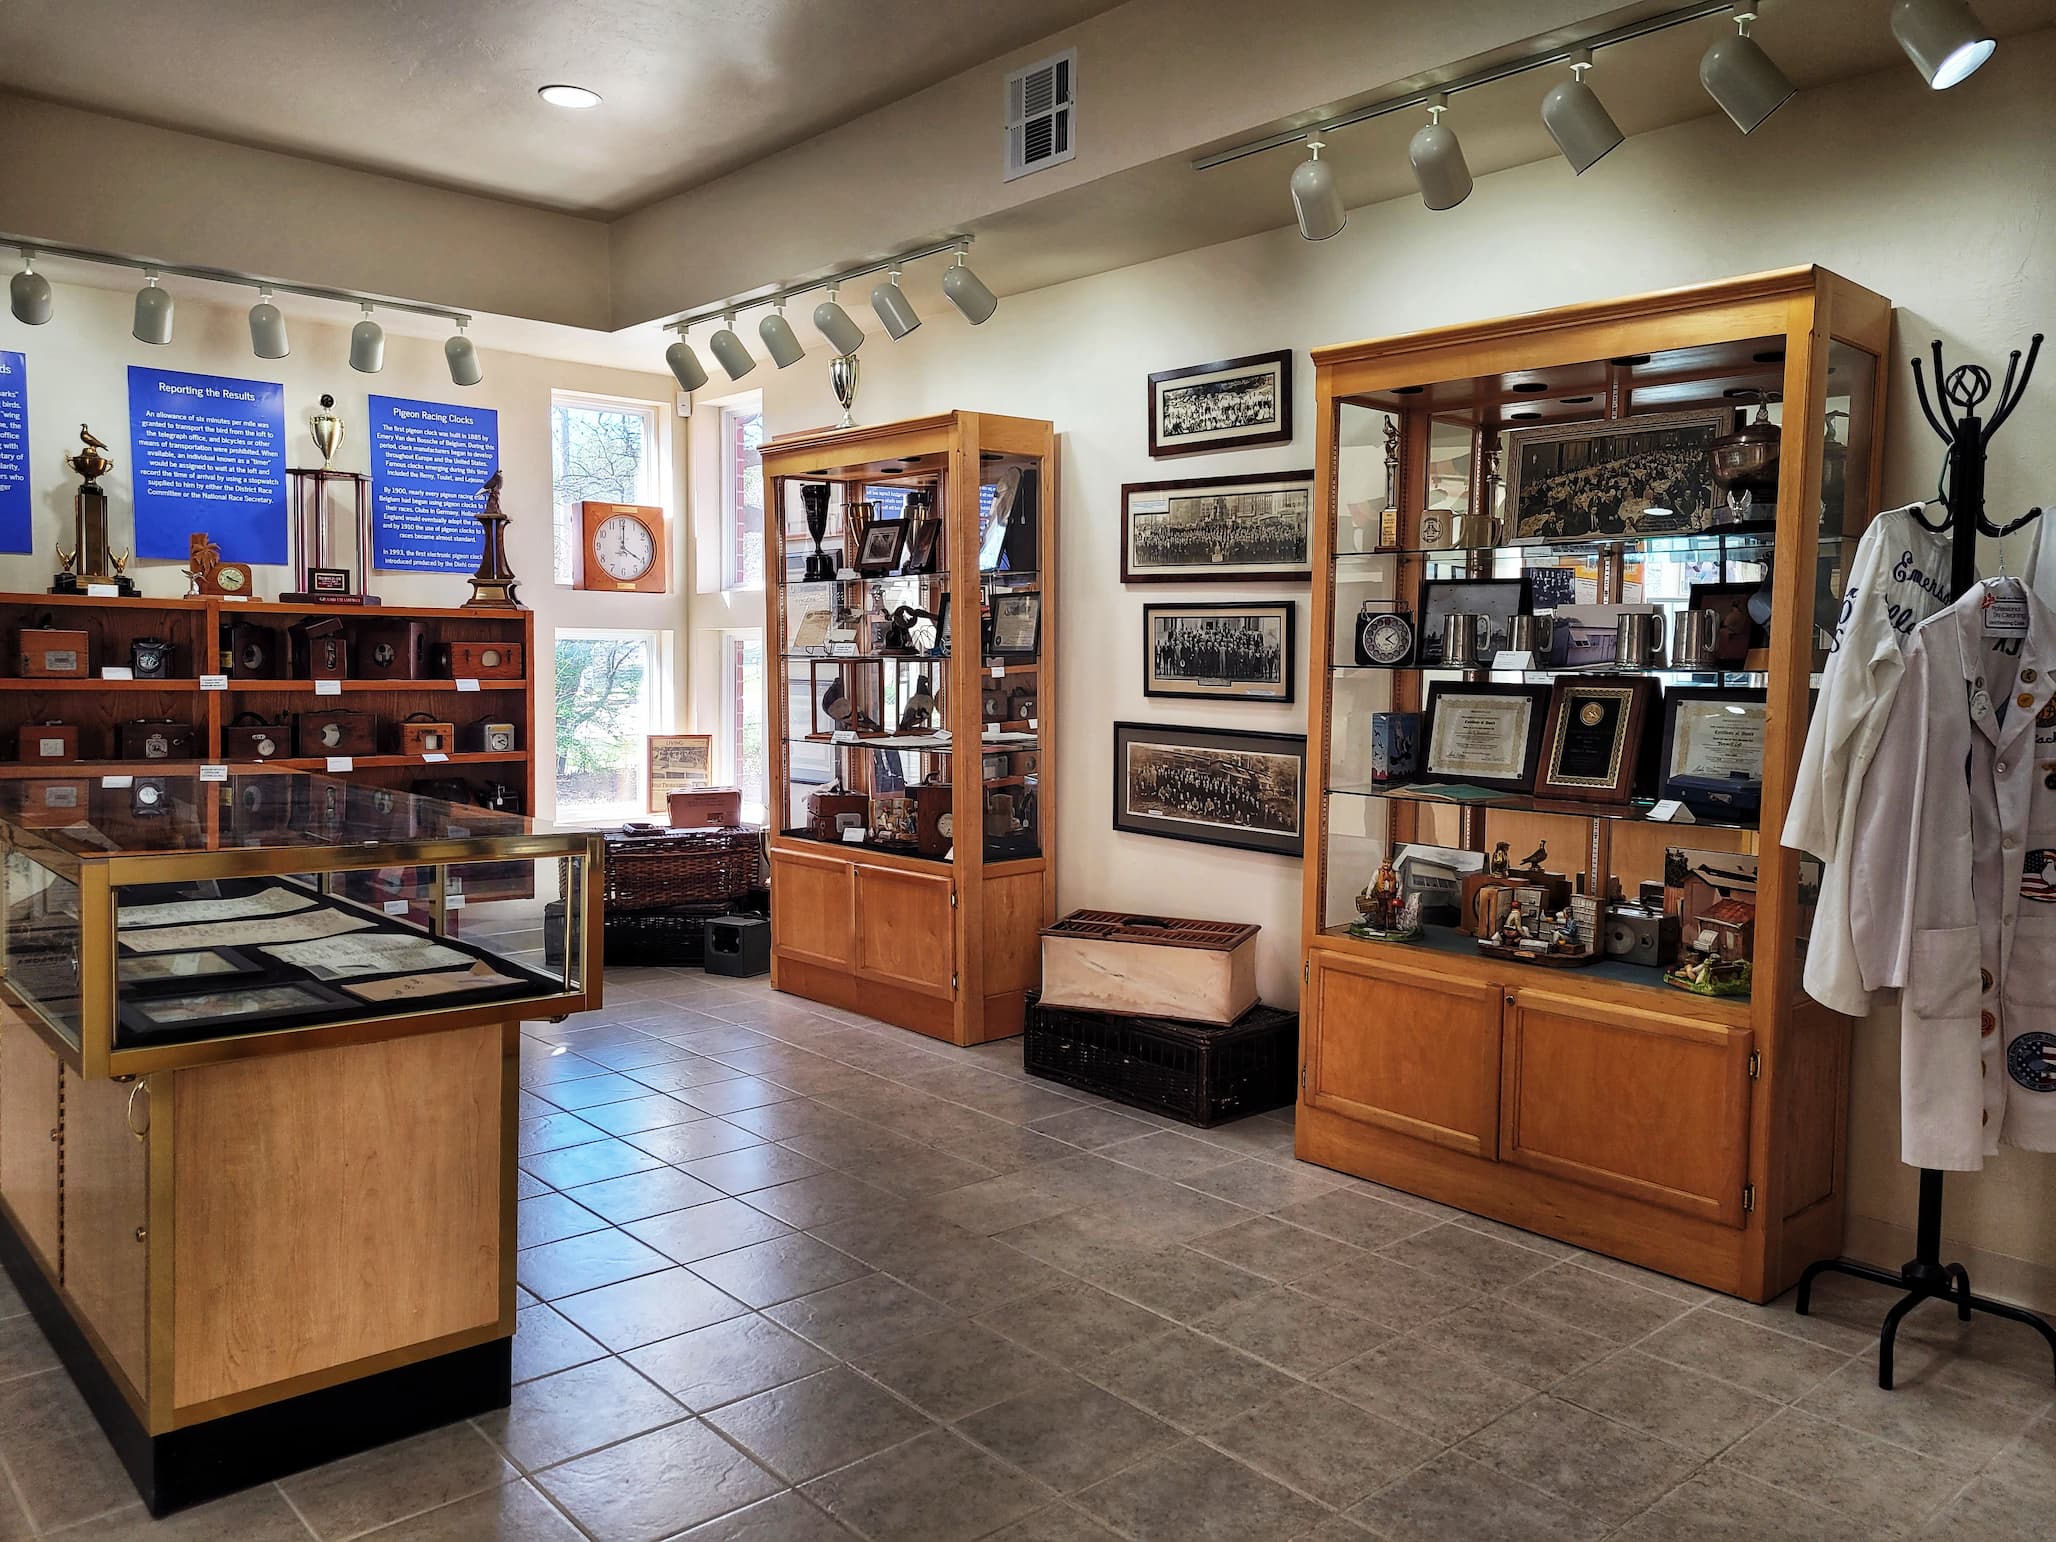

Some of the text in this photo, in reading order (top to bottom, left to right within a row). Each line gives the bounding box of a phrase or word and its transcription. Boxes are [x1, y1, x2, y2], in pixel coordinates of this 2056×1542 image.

[159, 383, 256, 402] Reporting the Results
[156, 412, 187, 420] allowance
[393, 408, 474, 424] Pigeon Racing Clocks
[141, 420, 166, 429] granted
[175, 423, 204, 432] transport
[158, 431, 188, 441] telegraph
[169, 442, 212, 452] transportation
[179, 462, 206, 471] assigned
[148, 479, 174, 488] supplied
[248, 478, 279, 486] stopwatch
[244, 496, 273, 504] Secretary.
[1892, 550, 1952, 606] Emerso
